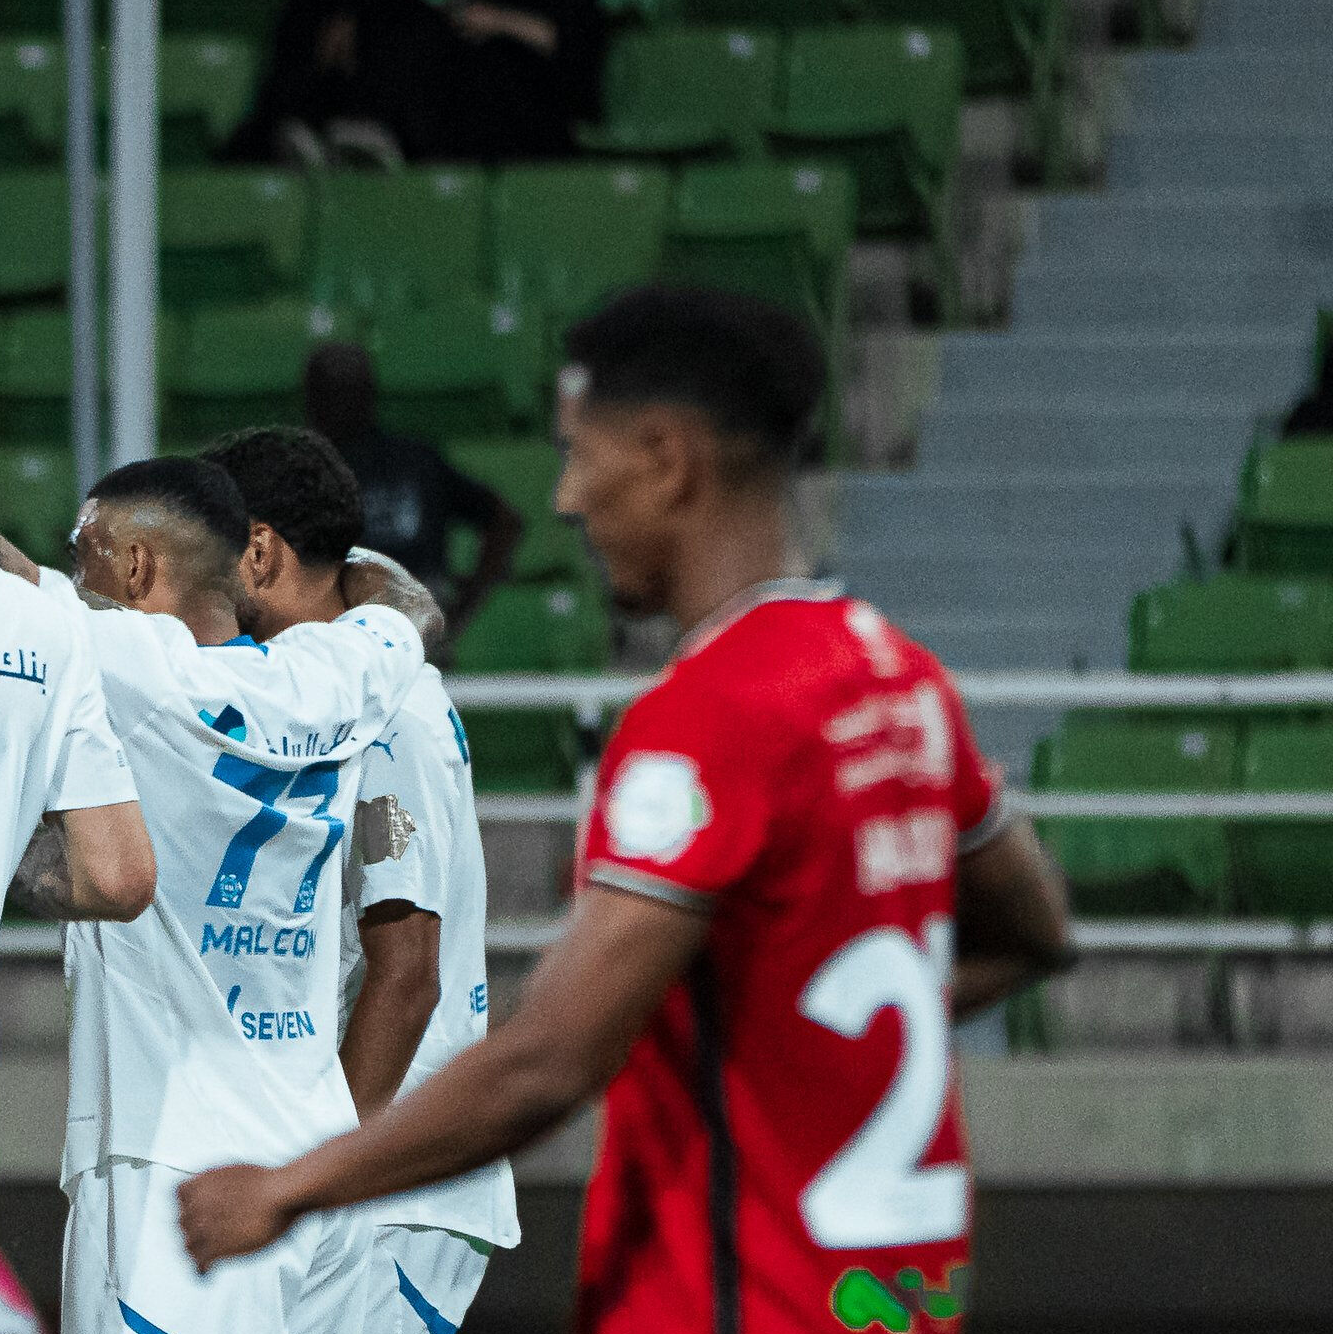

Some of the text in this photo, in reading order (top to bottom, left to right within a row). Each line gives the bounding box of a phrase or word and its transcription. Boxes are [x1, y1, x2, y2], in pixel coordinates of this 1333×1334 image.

[205, 751, 345, 914] 77
[240, 1010, 317, 1042] SEVEN
[797, 917, 970, 1250] 2
